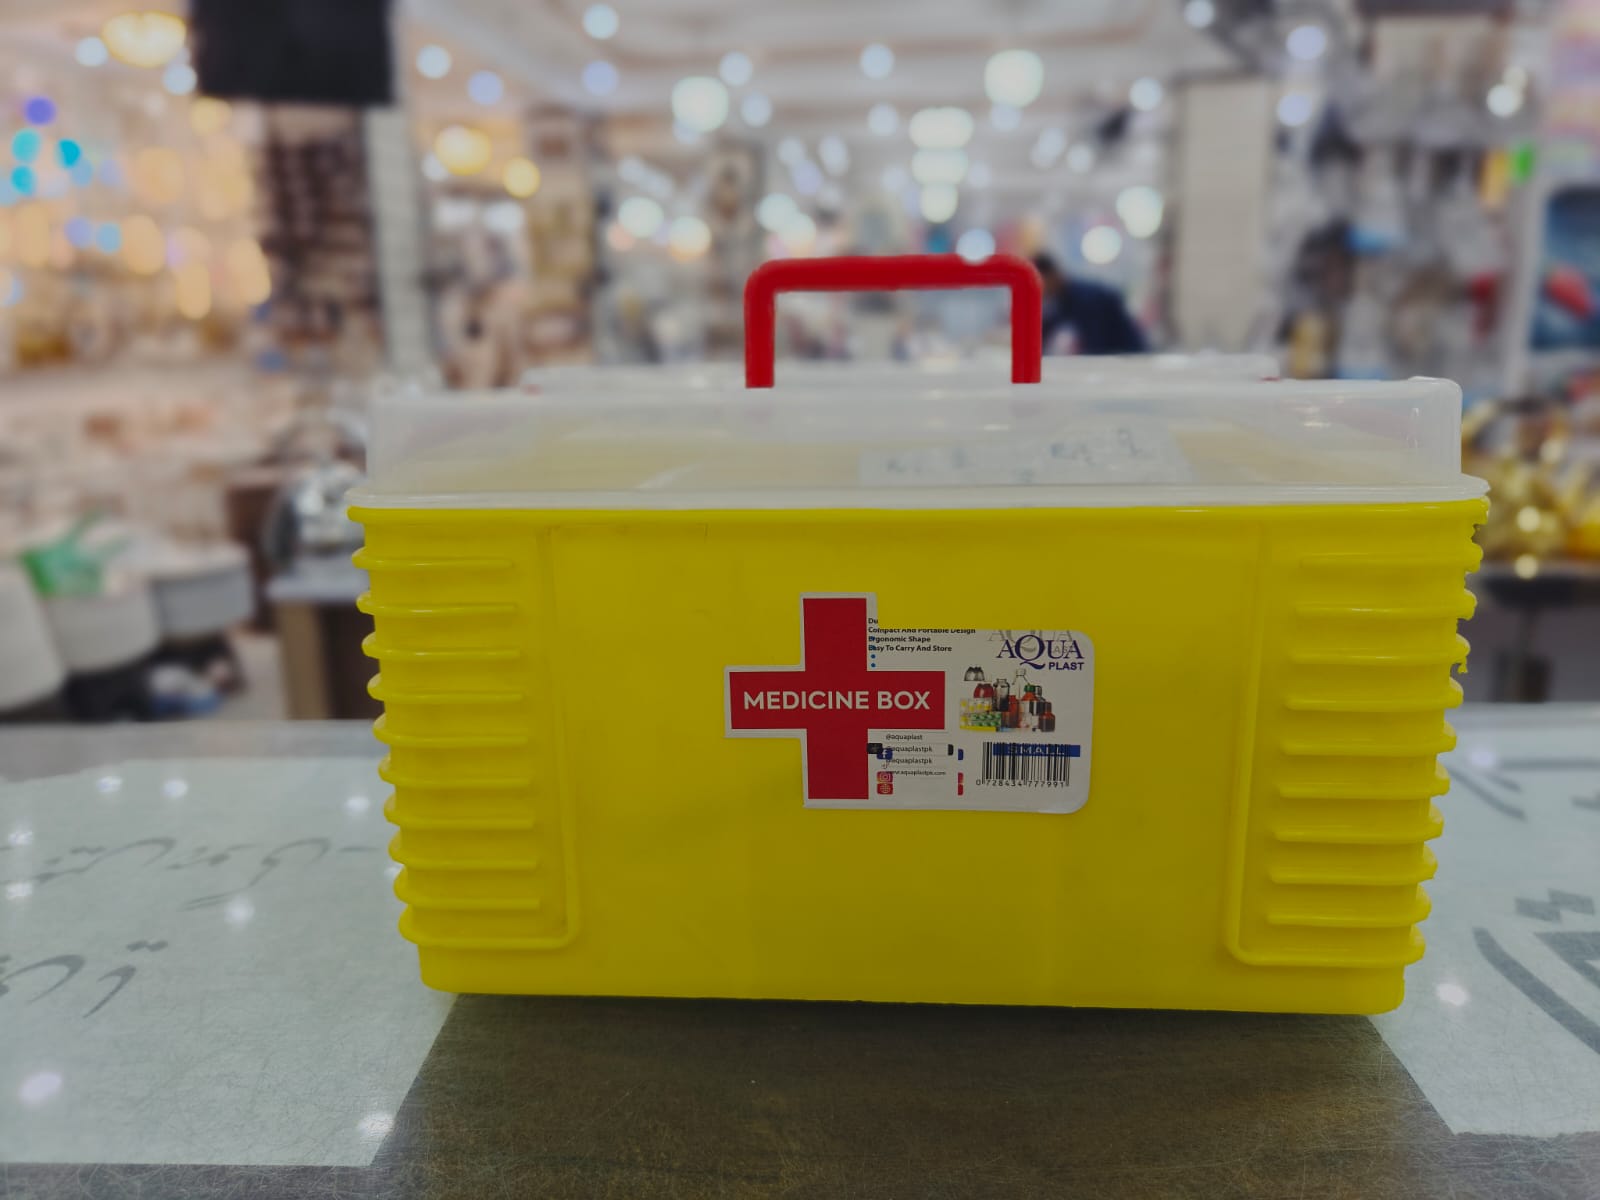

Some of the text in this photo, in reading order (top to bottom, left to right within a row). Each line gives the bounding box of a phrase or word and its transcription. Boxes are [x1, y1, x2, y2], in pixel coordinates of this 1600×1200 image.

[908, 636, 931, 644] Shape
[895, 645, 915, 653] Carry
[996, 634, 1085, 670] AQUA
[1049, 662, 1085, 671] PLAST
[743, 691, 930, 710] MEDICINE BOX
[885, 733, 923, 741] @aquaplast
[1026, 780, 1065, 789] 777991
